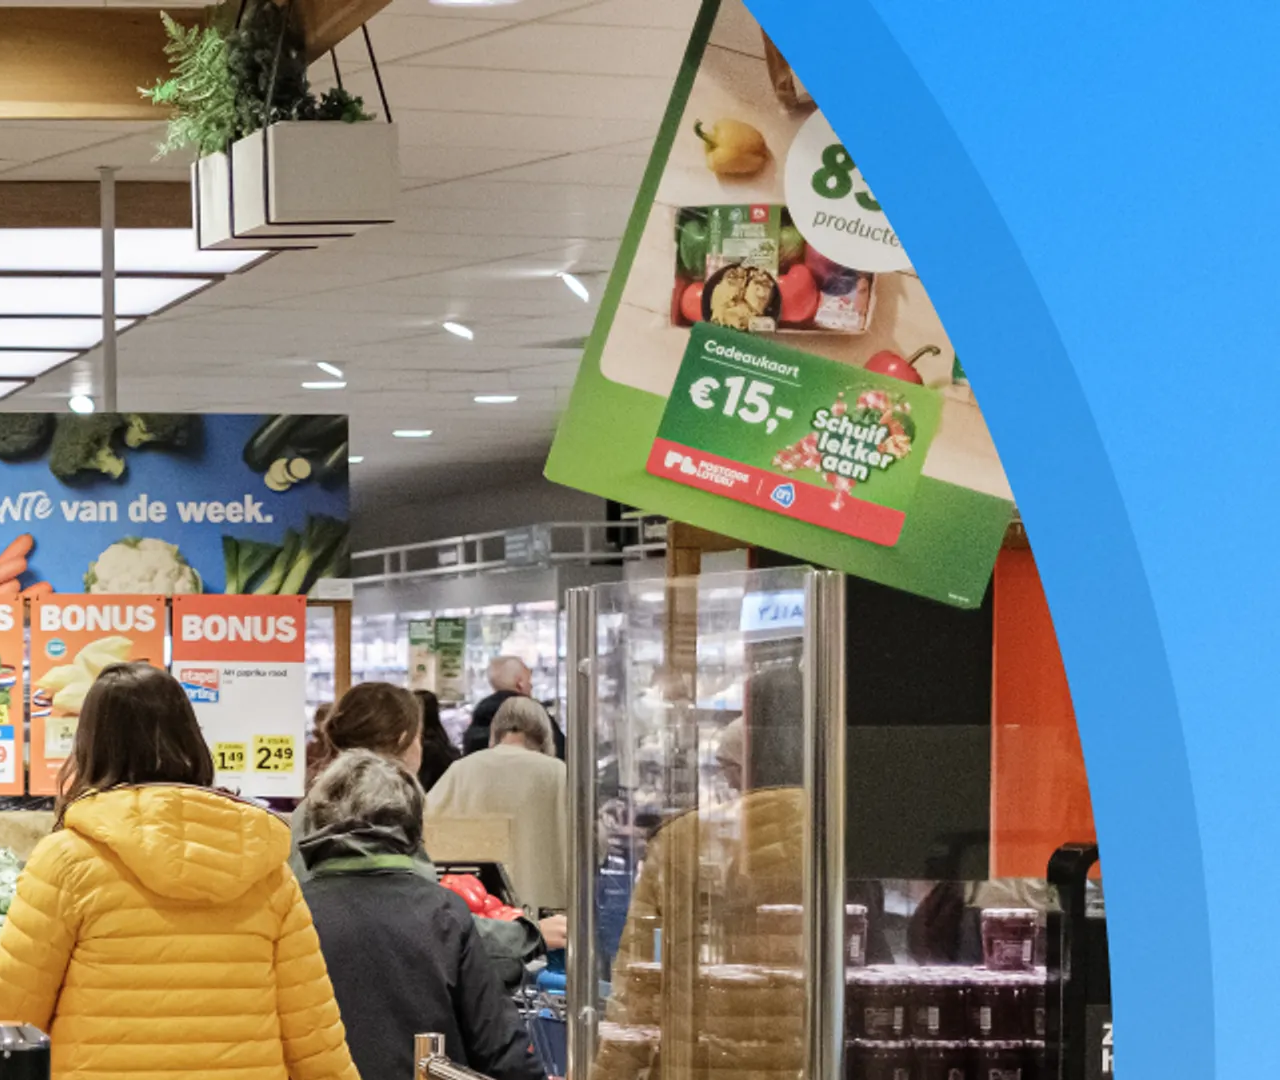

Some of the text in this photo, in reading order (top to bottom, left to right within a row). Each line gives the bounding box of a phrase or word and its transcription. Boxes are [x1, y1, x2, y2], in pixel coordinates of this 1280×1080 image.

[813, 210, 903, 250] producte
[704, 339, 799, 379] Cadeaukaart
[690, 375, 793, 434] €15,-
[813, 409, 889, 445] Schuif
[818, 432, 894, 470] lekker
[822, 454, 868, 481] aan
[61, 499, 118, 523] van
[128, 493, 167, 523] de
[177, 493, 274, 523] week.
[41, 604, 156, 632] BONUS
[182, 615, 297, 643] BONUS
